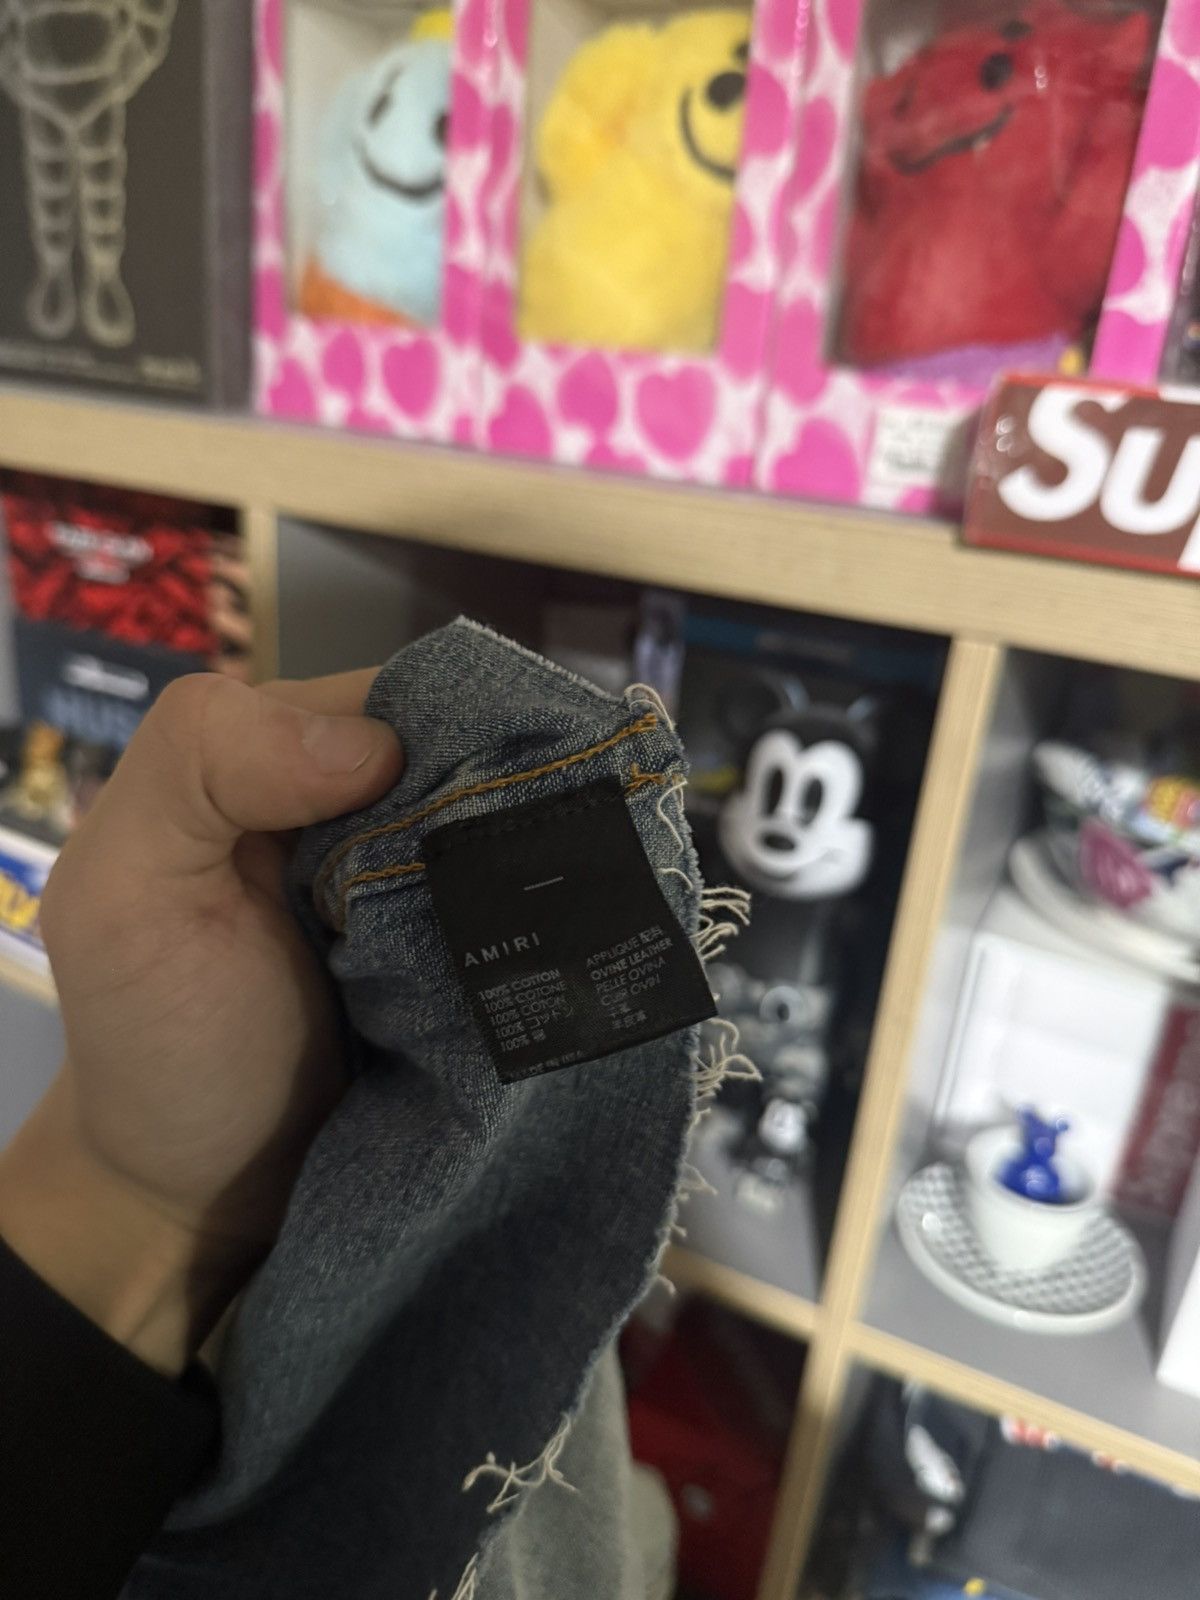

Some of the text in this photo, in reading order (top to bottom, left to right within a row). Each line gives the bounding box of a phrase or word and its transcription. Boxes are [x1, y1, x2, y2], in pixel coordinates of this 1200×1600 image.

[464, 932, 540, 968] AMIRI
[590, 937, 673, 981] OVINE LEATHER
[479, 968, 561, 1001] 100% COTTON
[484, 980, 566, 1014] 100% COTONE
[491, 1008, 520, 1027] 100%
[496, 1021, 525, 1039] 100%
